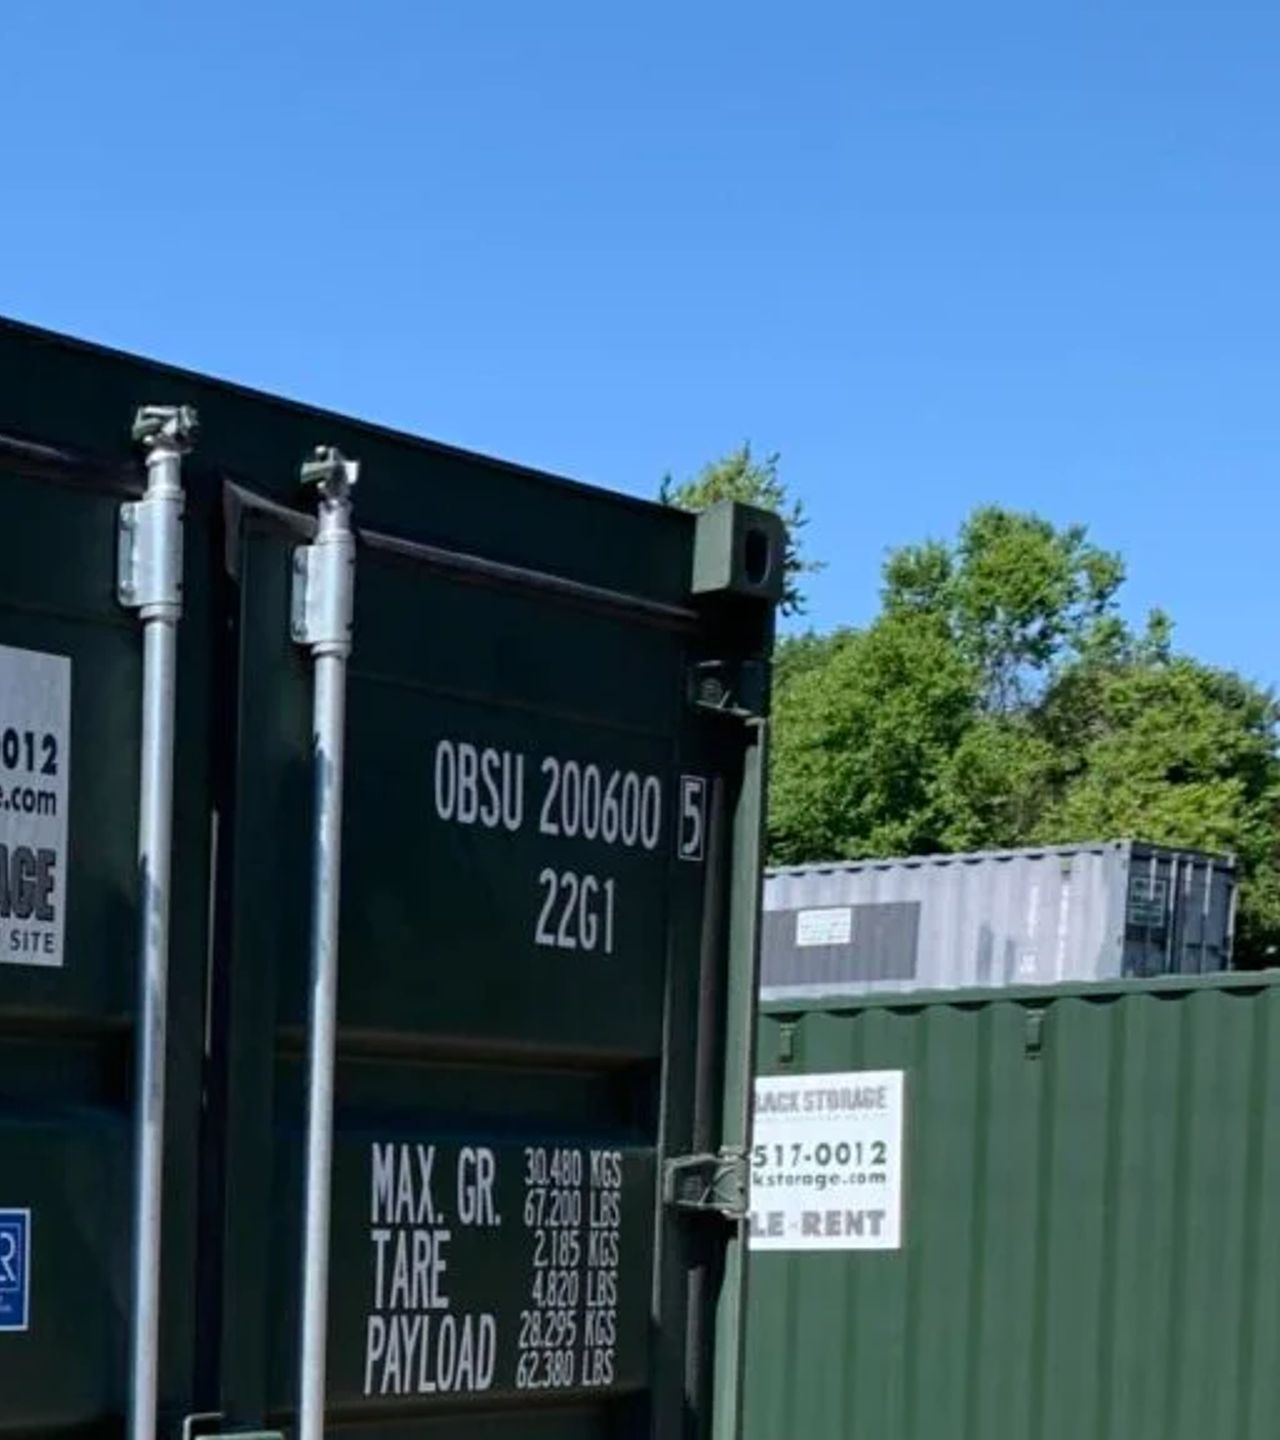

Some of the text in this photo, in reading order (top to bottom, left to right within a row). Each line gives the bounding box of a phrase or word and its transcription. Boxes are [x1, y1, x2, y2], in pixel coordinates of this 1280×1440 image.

[434, 739, 702, 856] OBSU 200600 5
[535, 868, 614, 953] 22G1
[10, 930, 55, 954] SITE
[753, 1140, 887, 1168] 517-0012
[370, 1142, 443, 1224] MAX.
[457, 1146, 501, 1226] GR.
[590, 1149, 622, 1188] KGS
[590, 1190, 621, 1228] LBS
[801, 1209, 886, 1237] RENT
[370, 1229, 451, 1309] TARE
[587, 1230, 619, 1267] KGS
[587, 1270, 618, 1307] LBS
[364, 1313, 497, 1395] PAYLOAD
[585, 1310, 616, 1346] KGS
[582, 1348, 614, 1386] LBS
